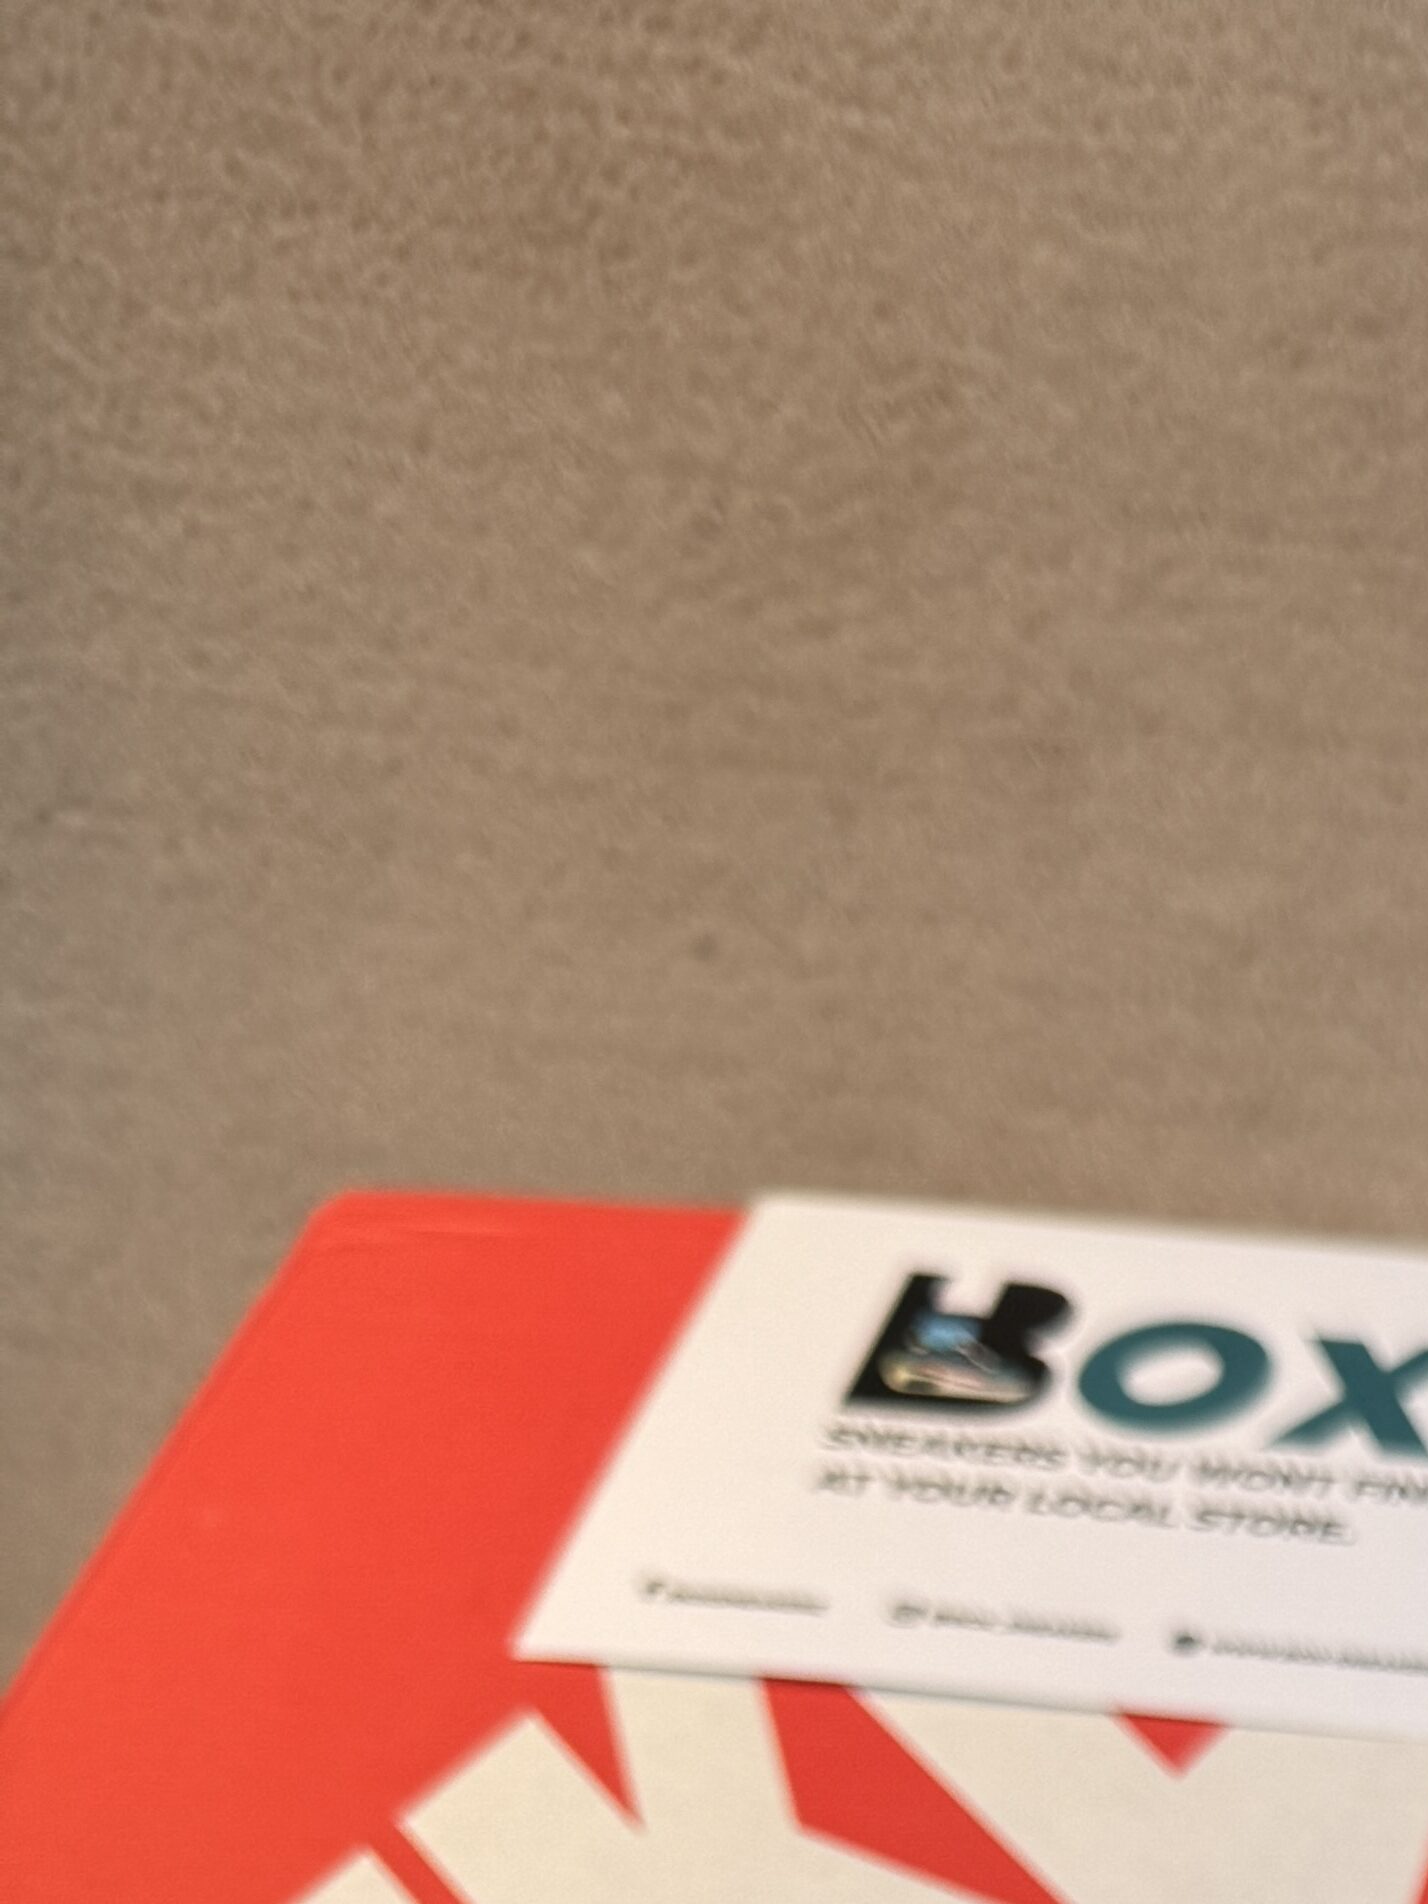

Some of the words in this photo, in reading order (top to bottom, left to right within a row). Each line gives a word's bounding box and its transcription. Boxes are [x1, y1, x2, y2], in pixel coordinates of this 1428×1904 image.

[1080, 1441, 1184, 1483] YOU
[819, 1463, 873, 1497] AT
[886, 1472, 1016, 1513] YOUR
[1022, 1486, 1182, 1528] LOCAL
